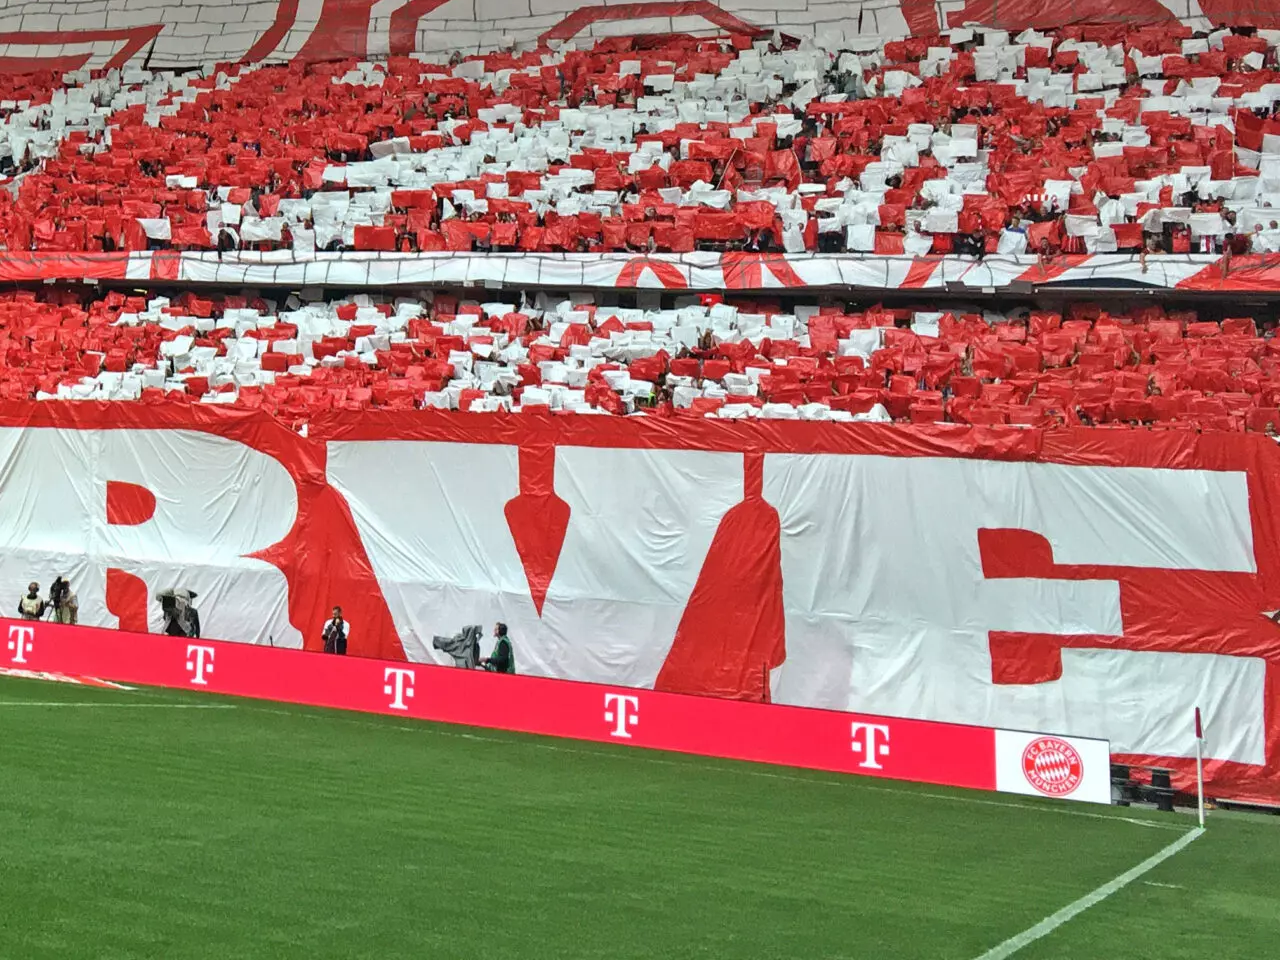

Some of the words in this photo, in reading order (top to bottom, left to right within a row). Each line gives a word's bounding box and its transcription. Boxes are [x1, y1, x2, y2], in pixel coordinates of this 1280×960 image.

[7, 624, 34, 664] T
[186, 645, 216, 685] T
[383, 666, 416, 710] T
[604, 693, 640, 738] T
[851, 722, 891, 770] T
[1027, 747, 1039, 760] FC
[1038, 741, 1078, 764] BAYERN
